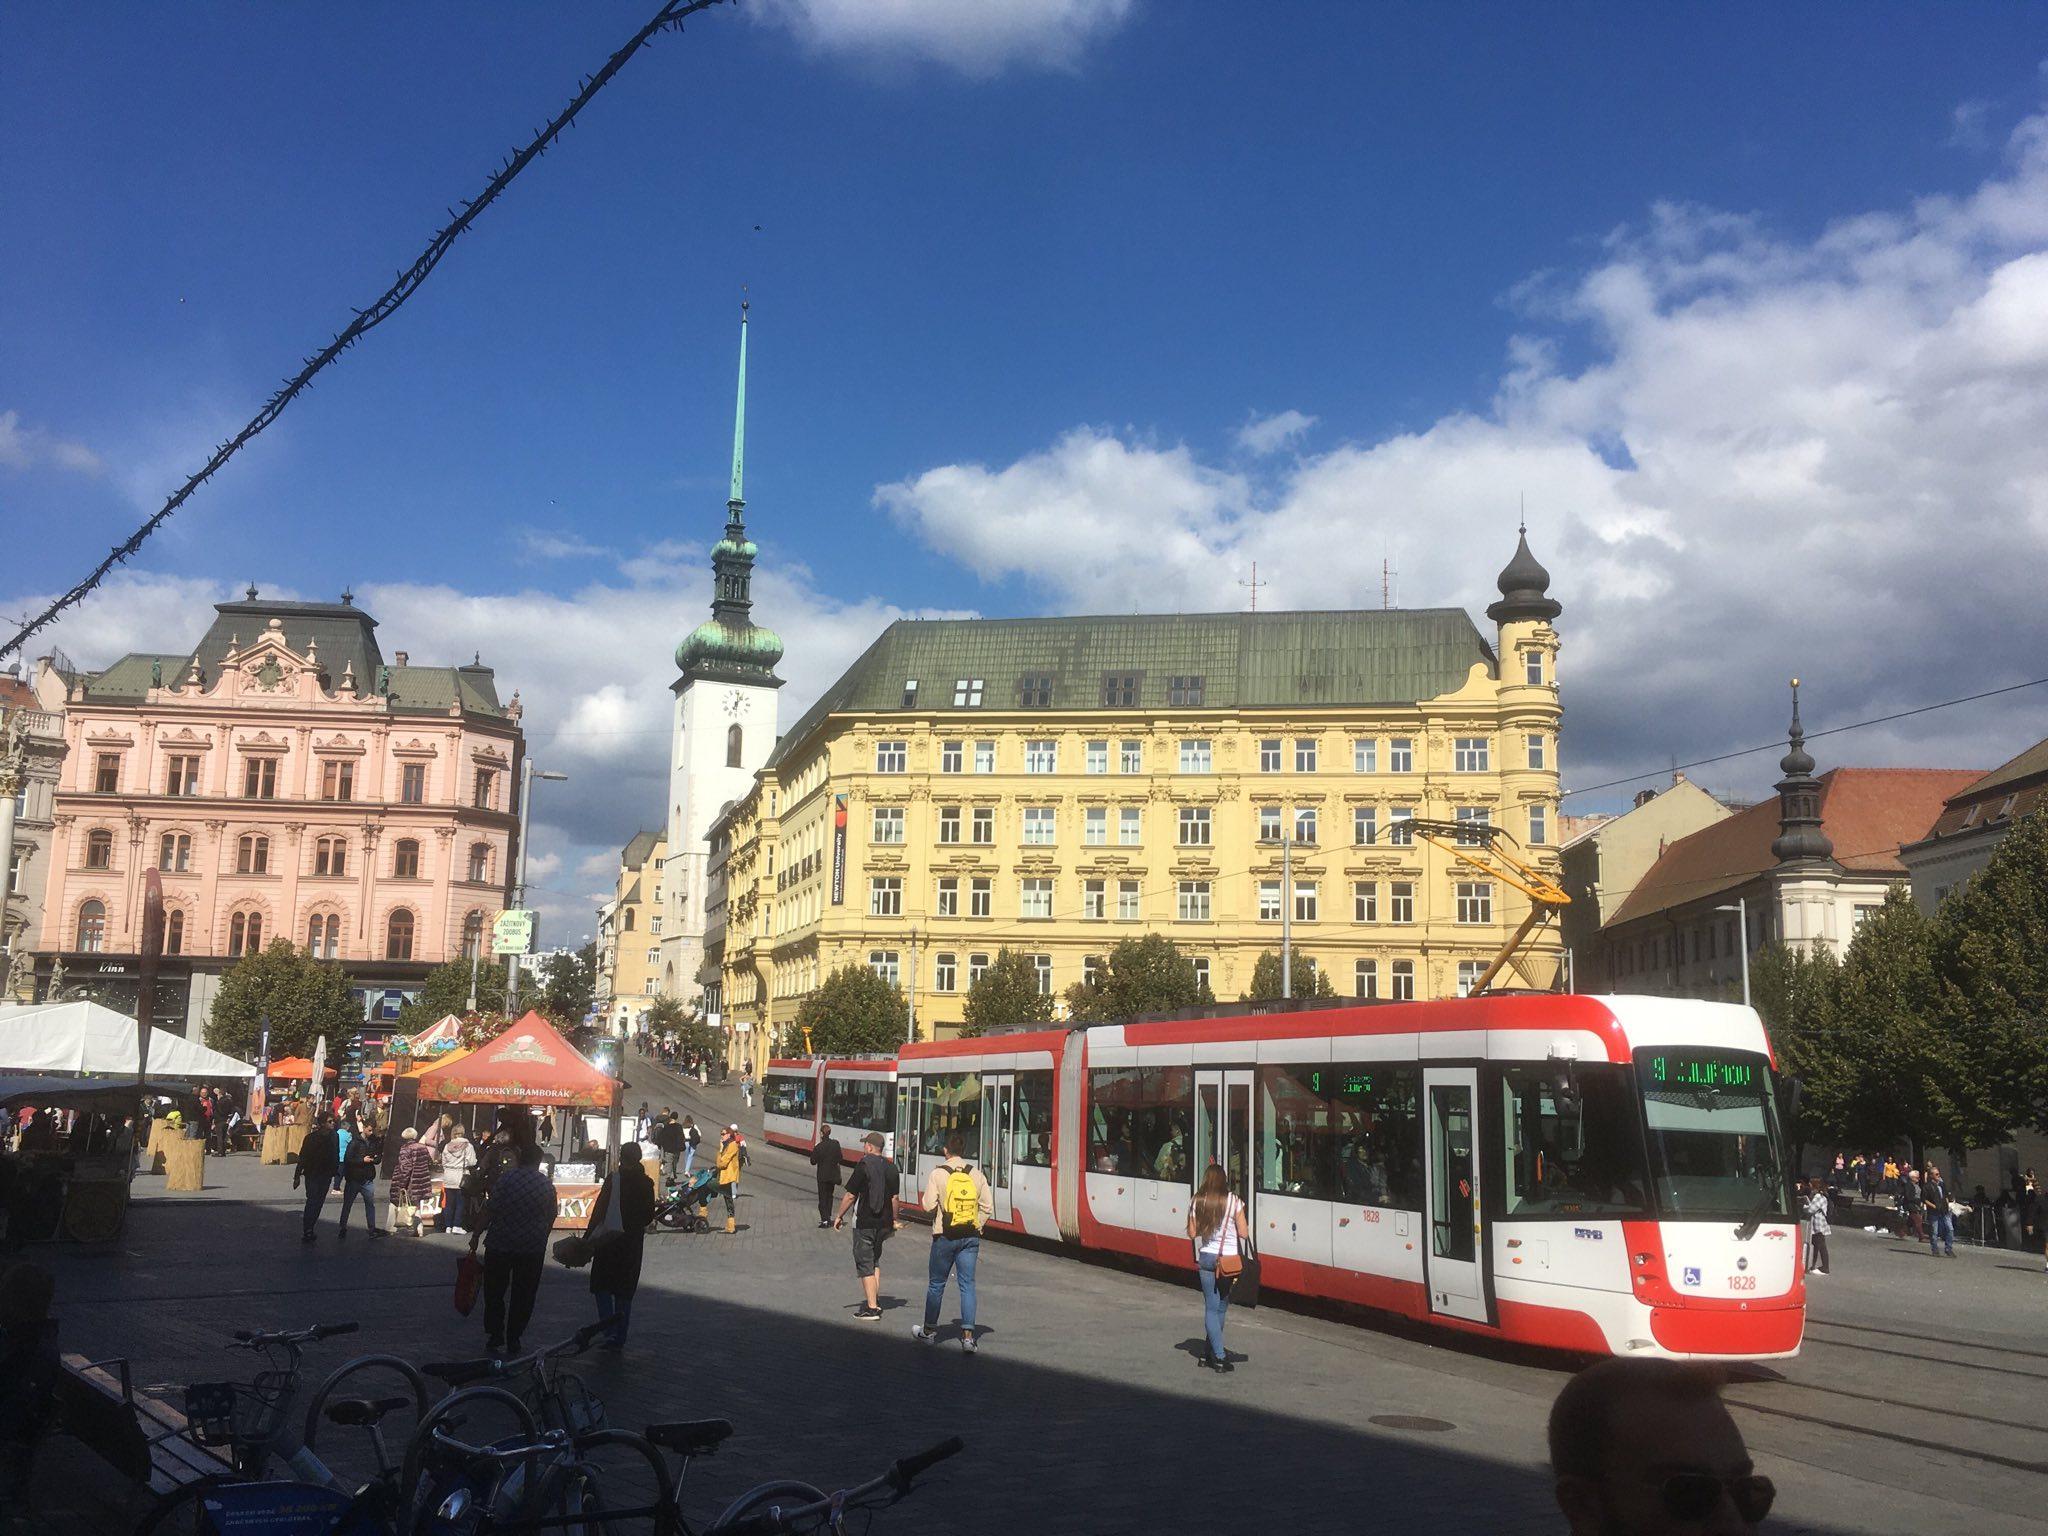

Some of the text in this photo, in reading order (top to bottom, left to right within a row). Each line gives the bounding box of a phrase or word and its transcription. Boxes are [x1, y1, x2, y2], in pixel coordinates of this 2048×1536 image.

[833, 868, 841, 902] NEWTON
[1363, 1209, 1380, 1223] 1828
[1727, 1275, 1756, 1290] 1828
